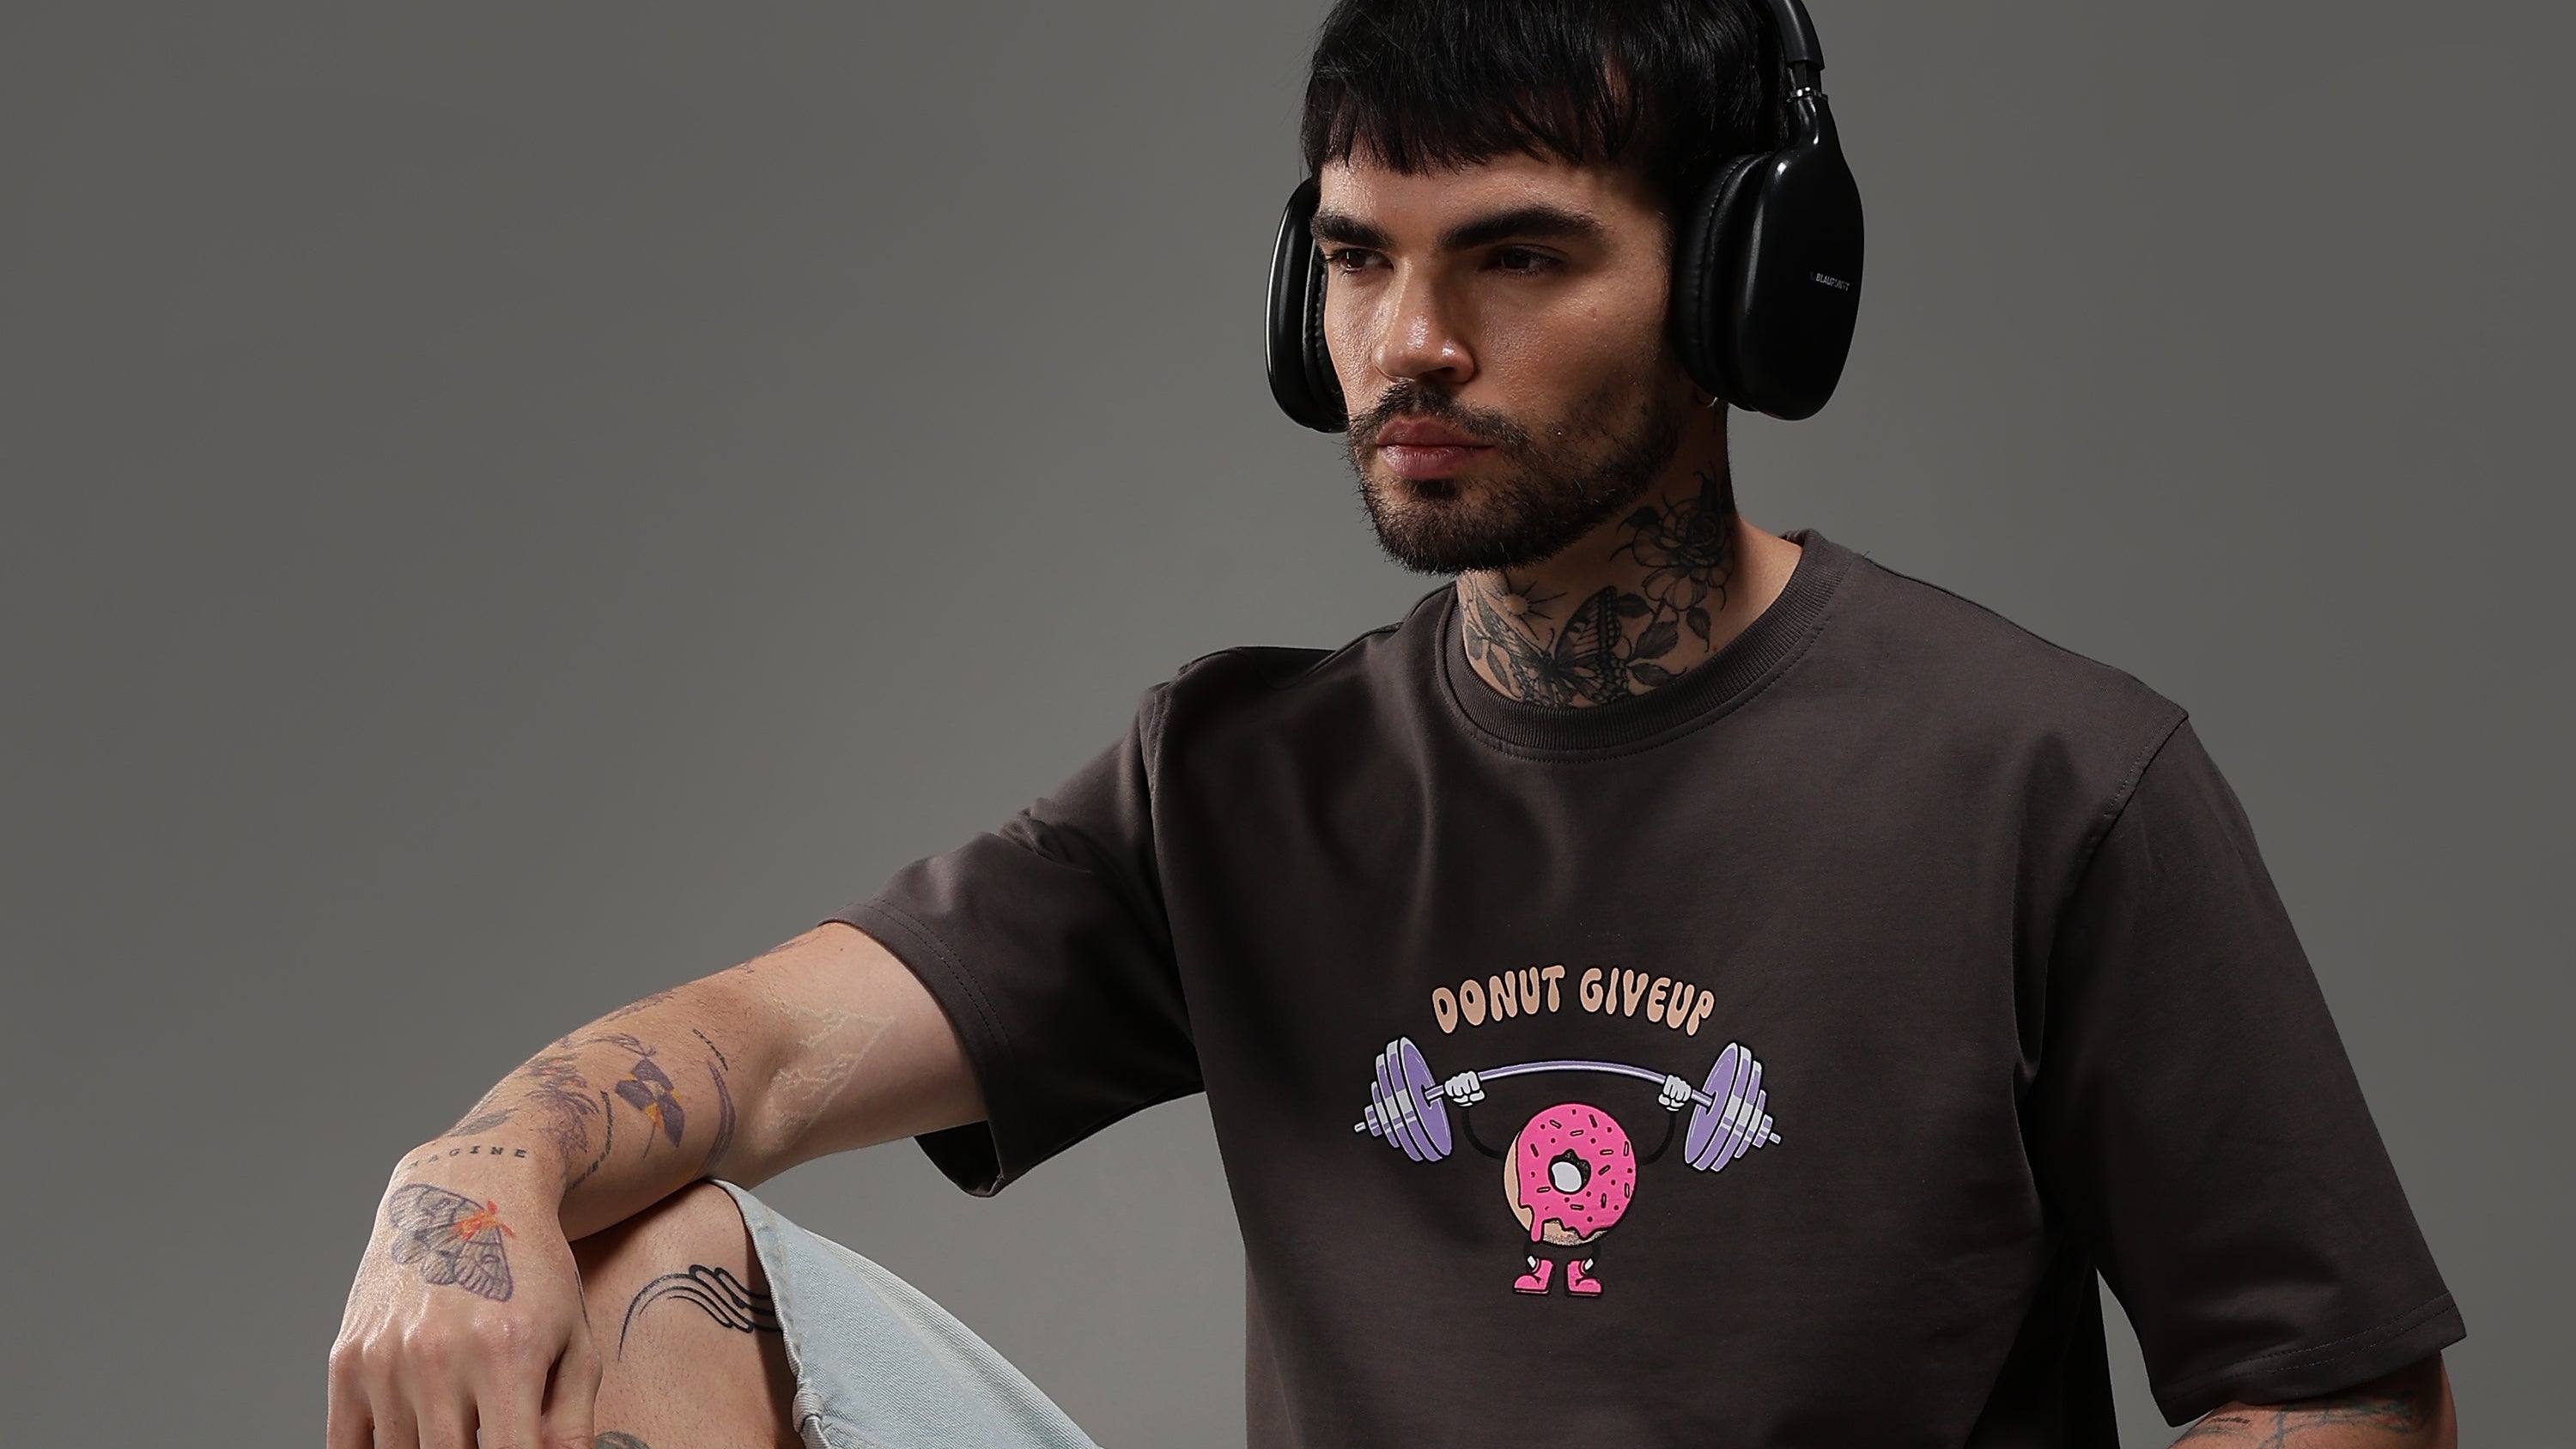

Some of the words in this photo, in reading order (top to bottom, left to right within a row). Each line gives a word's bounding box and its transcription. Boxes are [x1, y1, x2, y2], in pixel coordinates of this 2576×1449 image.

[1431, 965, 1565, 1034] DONUT
[1580, 967, 1715, 1036] GIVEUP
[396, 1144, 527, 1177] MAGINE
